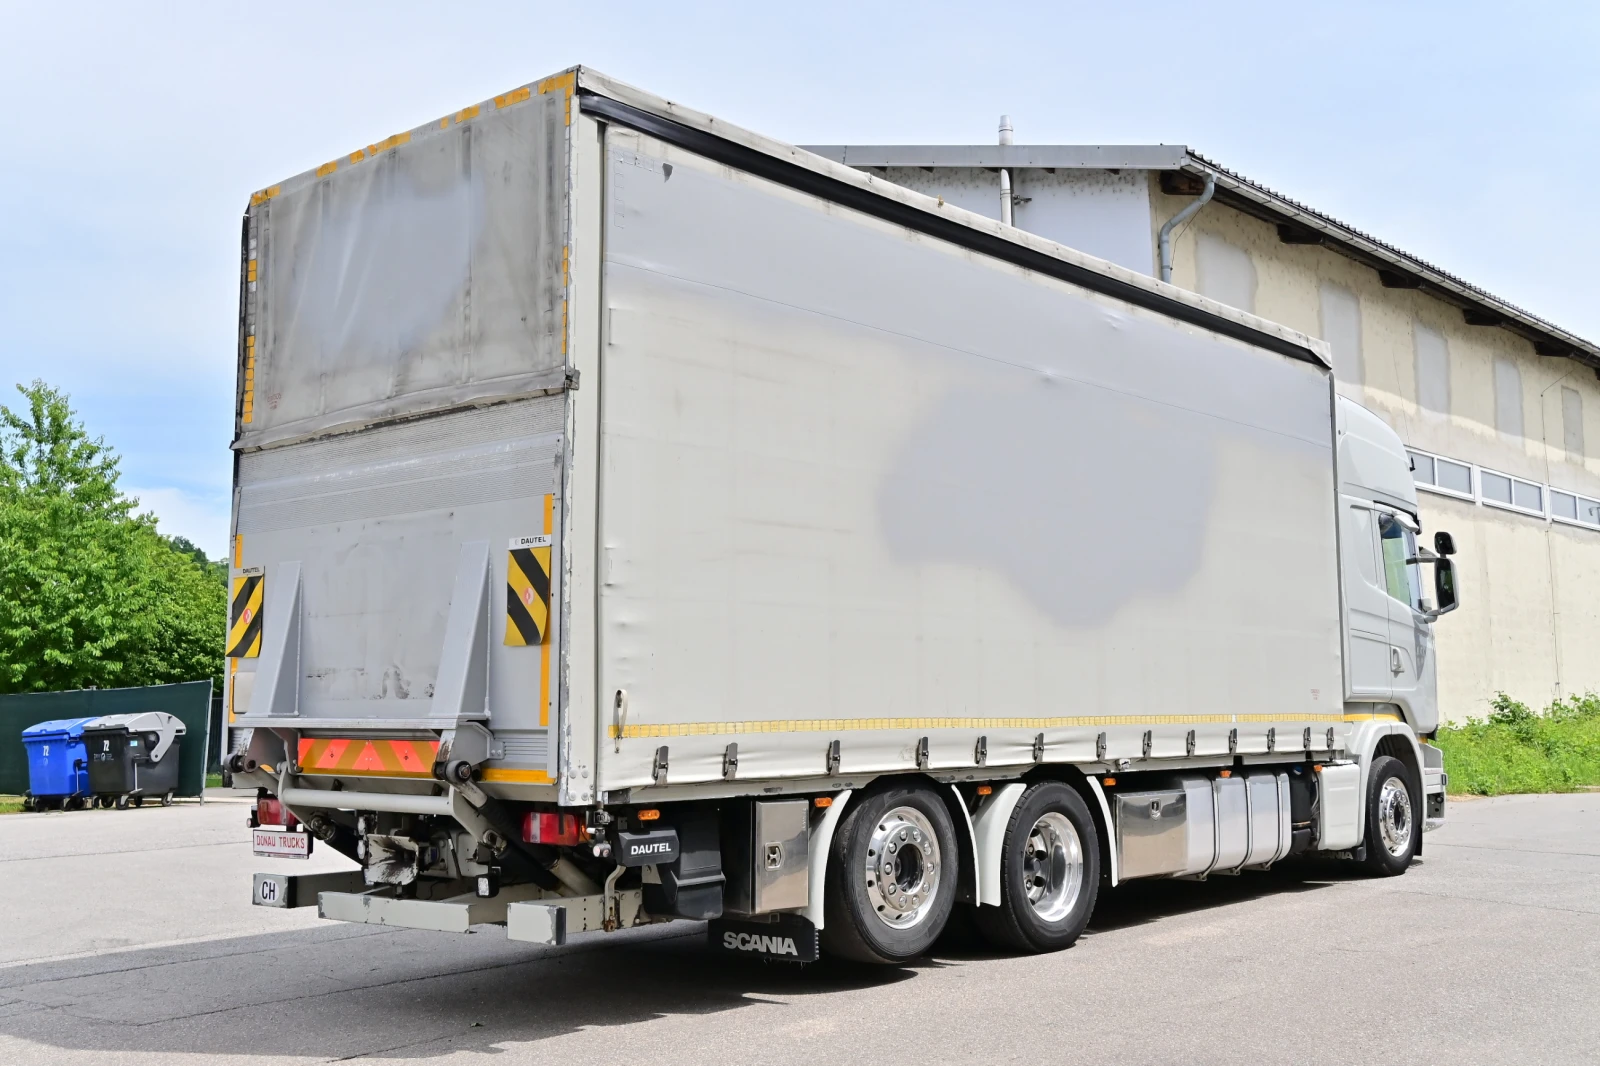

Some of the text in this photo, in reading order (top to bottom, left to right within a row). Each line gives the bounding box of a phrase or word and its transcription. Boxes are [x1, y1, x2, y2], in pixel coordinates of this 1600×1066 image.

[521, 536, 547, 544] DAUTEL
[242, 567, 261, 575] DAUTEL
[256, 835, 305, 849] DONAU TRUCKS
[630, 842, 672, 855] DAUTEL
[1317, 851, 1354, 860] CANIA
[262, 881, 275, 900] CH
[723, 931, 798, 956] SCANIA
